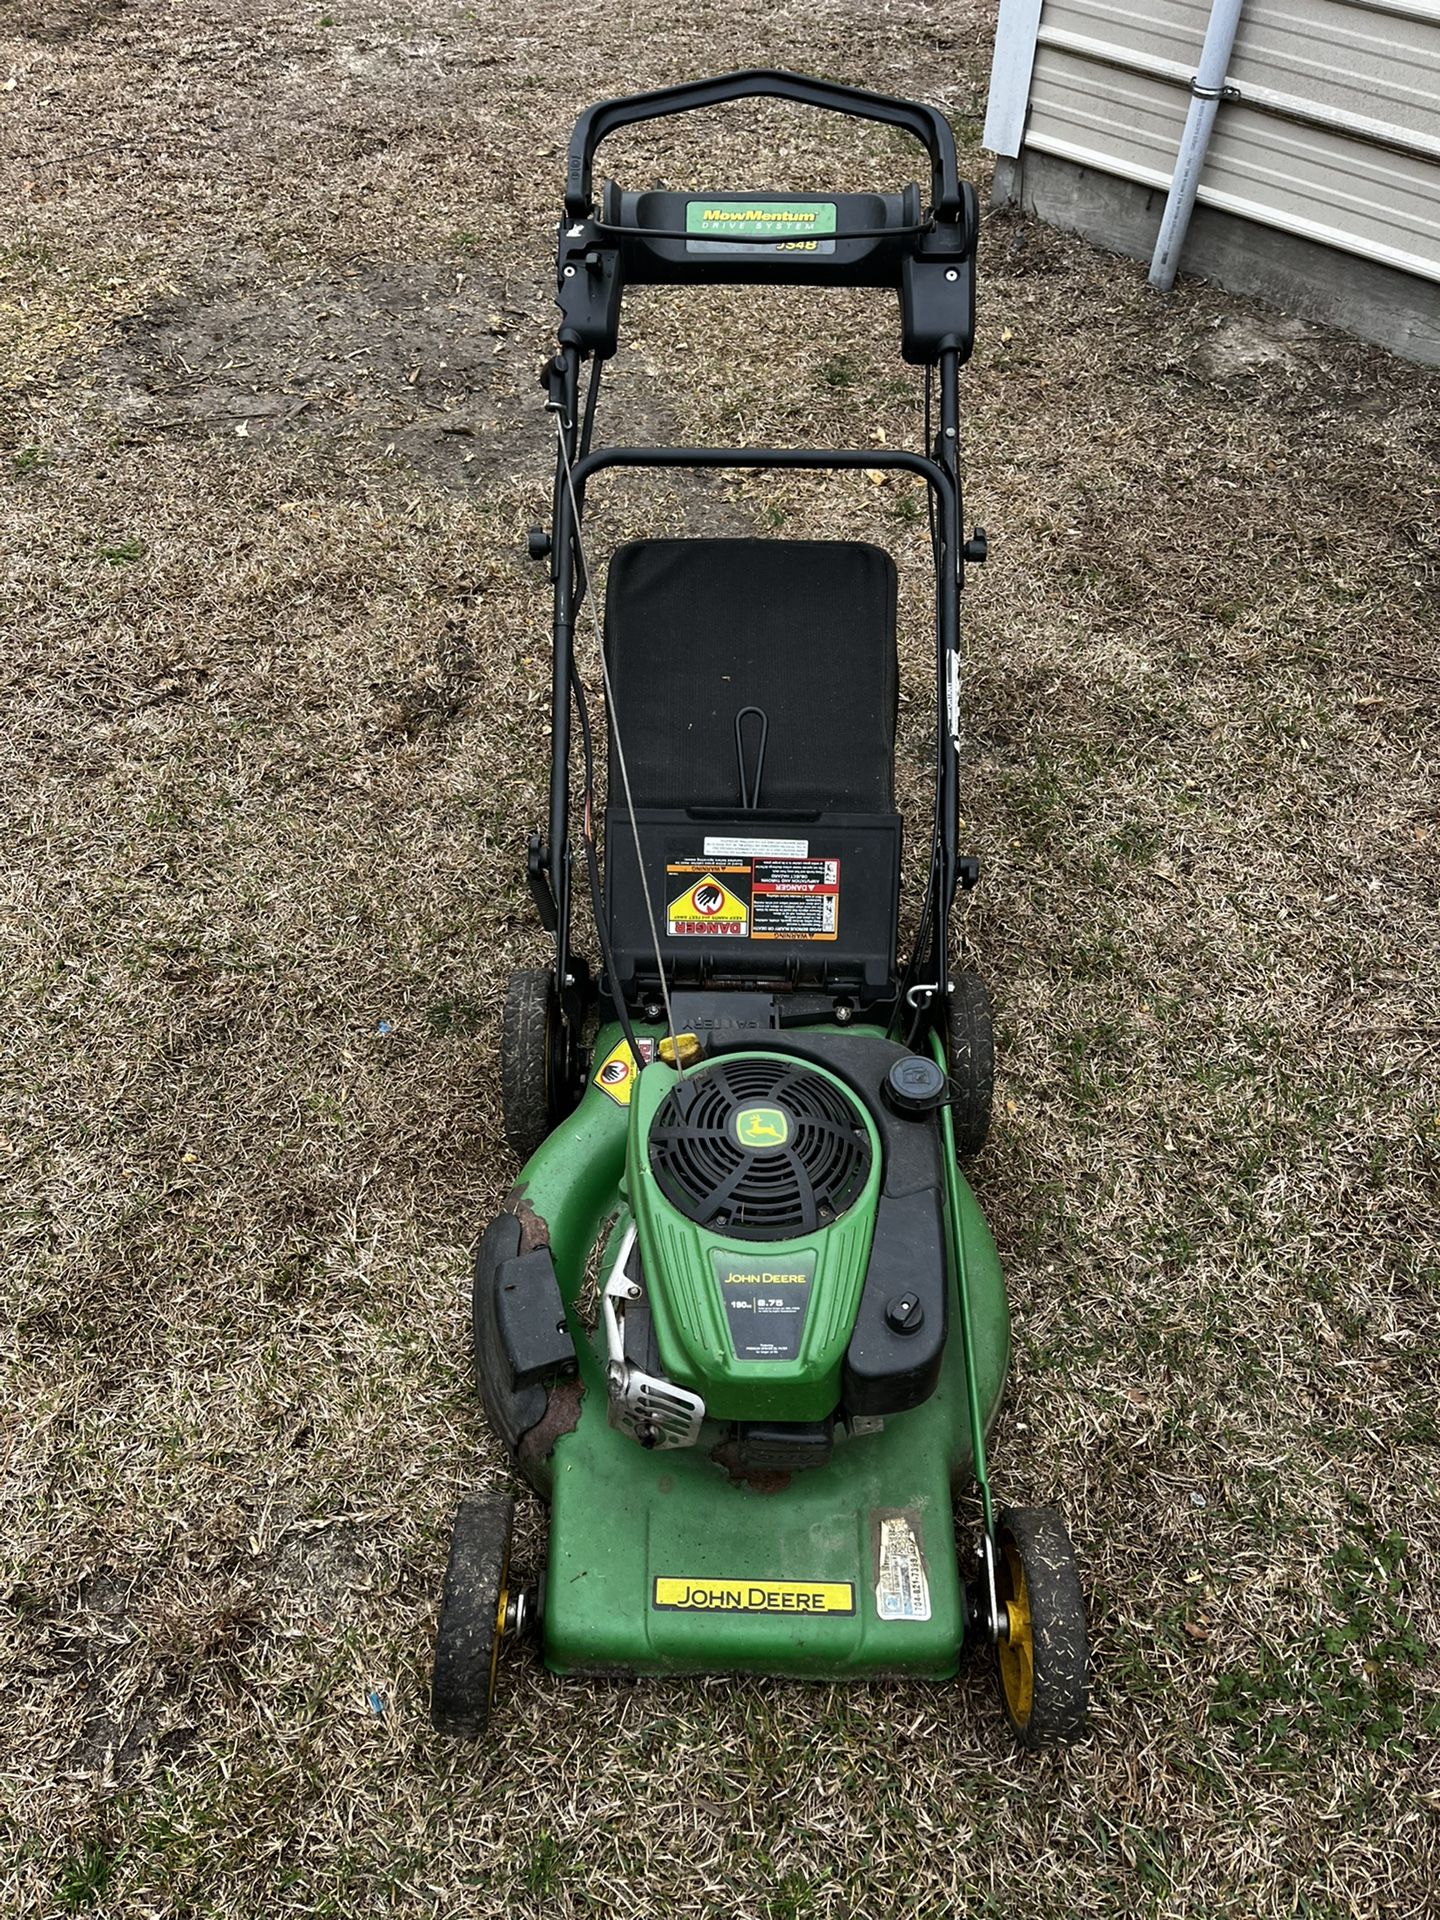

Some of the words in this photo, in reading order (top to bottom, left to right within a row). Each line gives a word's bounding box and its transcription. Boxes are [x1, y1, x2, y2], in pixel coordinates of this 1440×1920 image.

[703, 210, 816, 221] MowMentum
[675, 922, 741, 934] DANGER
[724, 1272, 760, 1284] JOHN
[762, 1273, 806, 1283] DEERE
[678, 1586, 742, 1606] JOHN
[748, 1588, 825, 1608] DEERE
